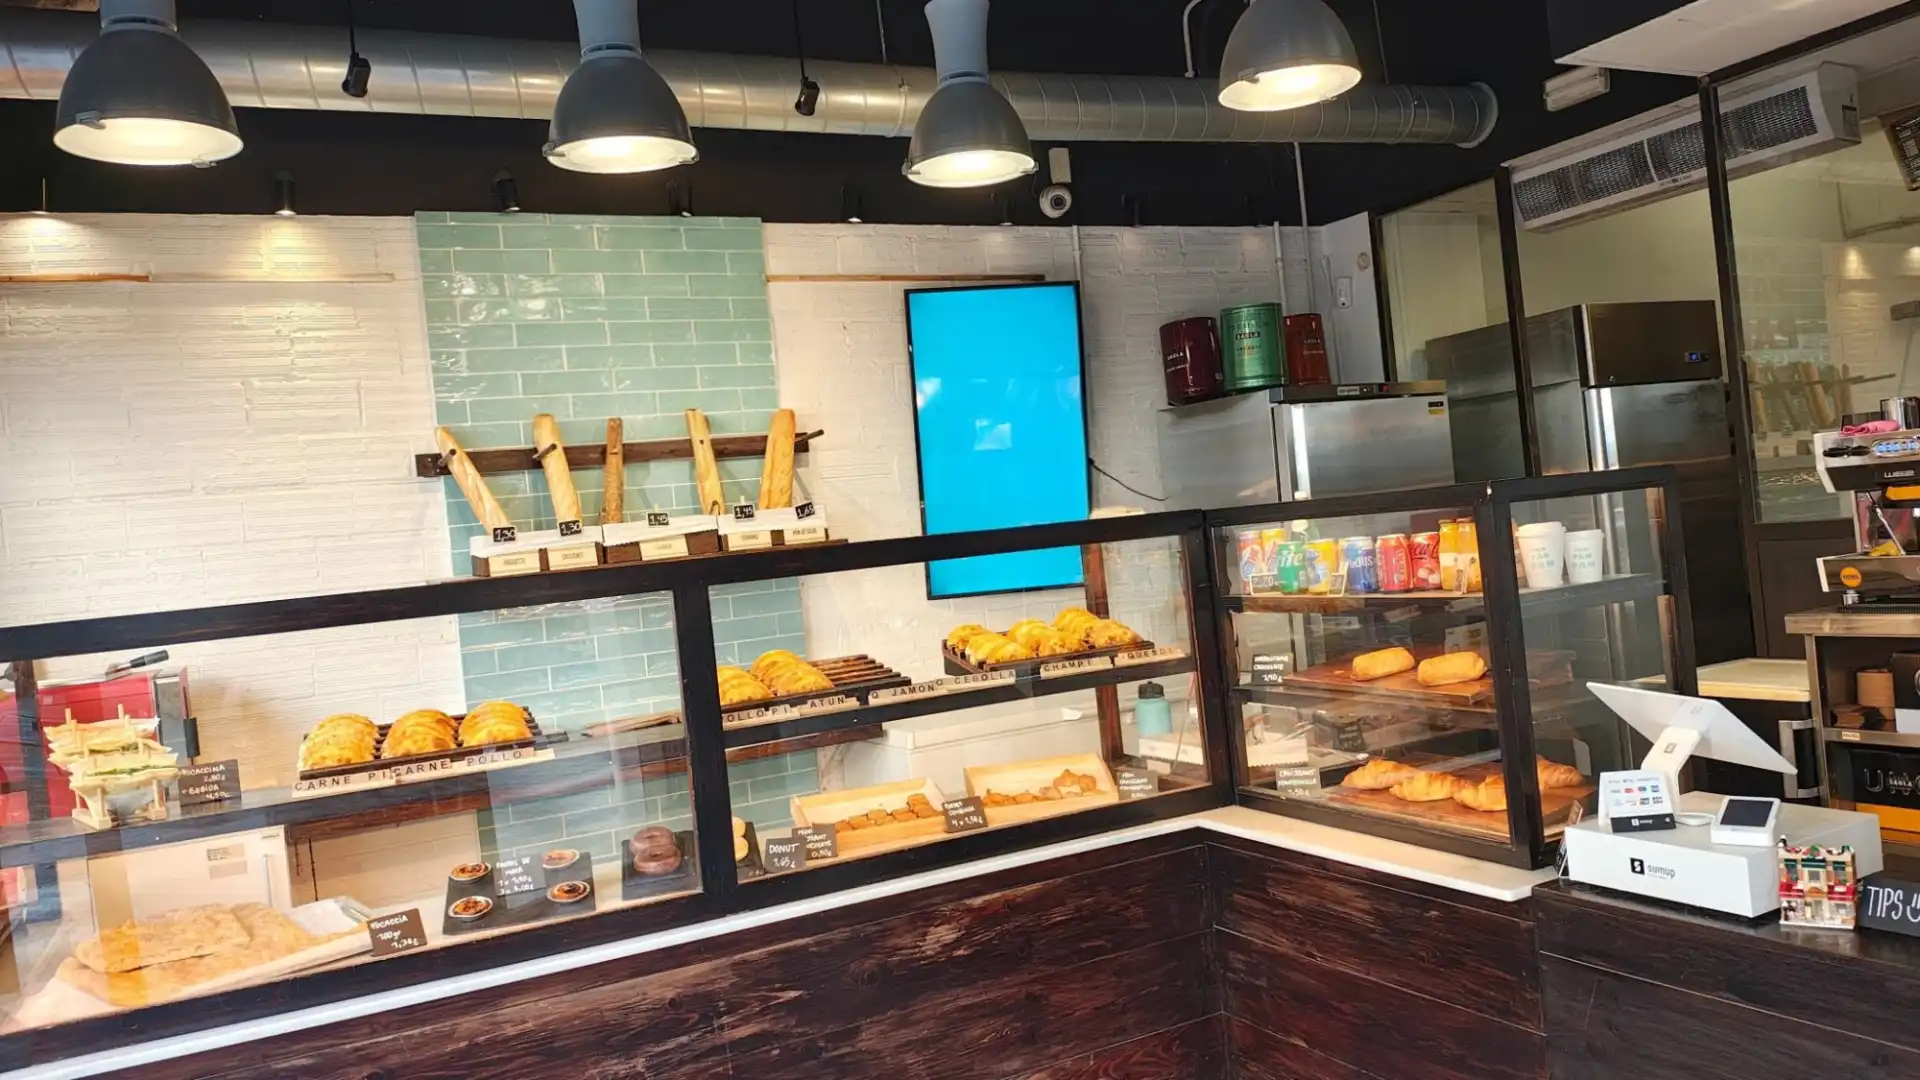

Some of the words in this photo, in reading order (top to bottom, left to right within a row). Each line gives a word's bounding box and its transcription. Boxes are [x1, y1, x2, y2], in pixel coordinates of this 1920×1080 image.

[735, 506, 754, 518] 1,45
[649, 514, 669, 525] 1,45
[560, 522, 581, 535] 1,30
[892, 684, 936, 697] JAMON
[810, 697, 845, 709] ATUN
[727, 709, 764, 722] OLLO
[467, 750, 523, 767] POLLO
[393, 760, 450, 777] CARNE
[294, 776, 352, 792] CARNE
[769, 843, 801, 854] DONUT
[1867, 886, 1903, 920] TIPS
